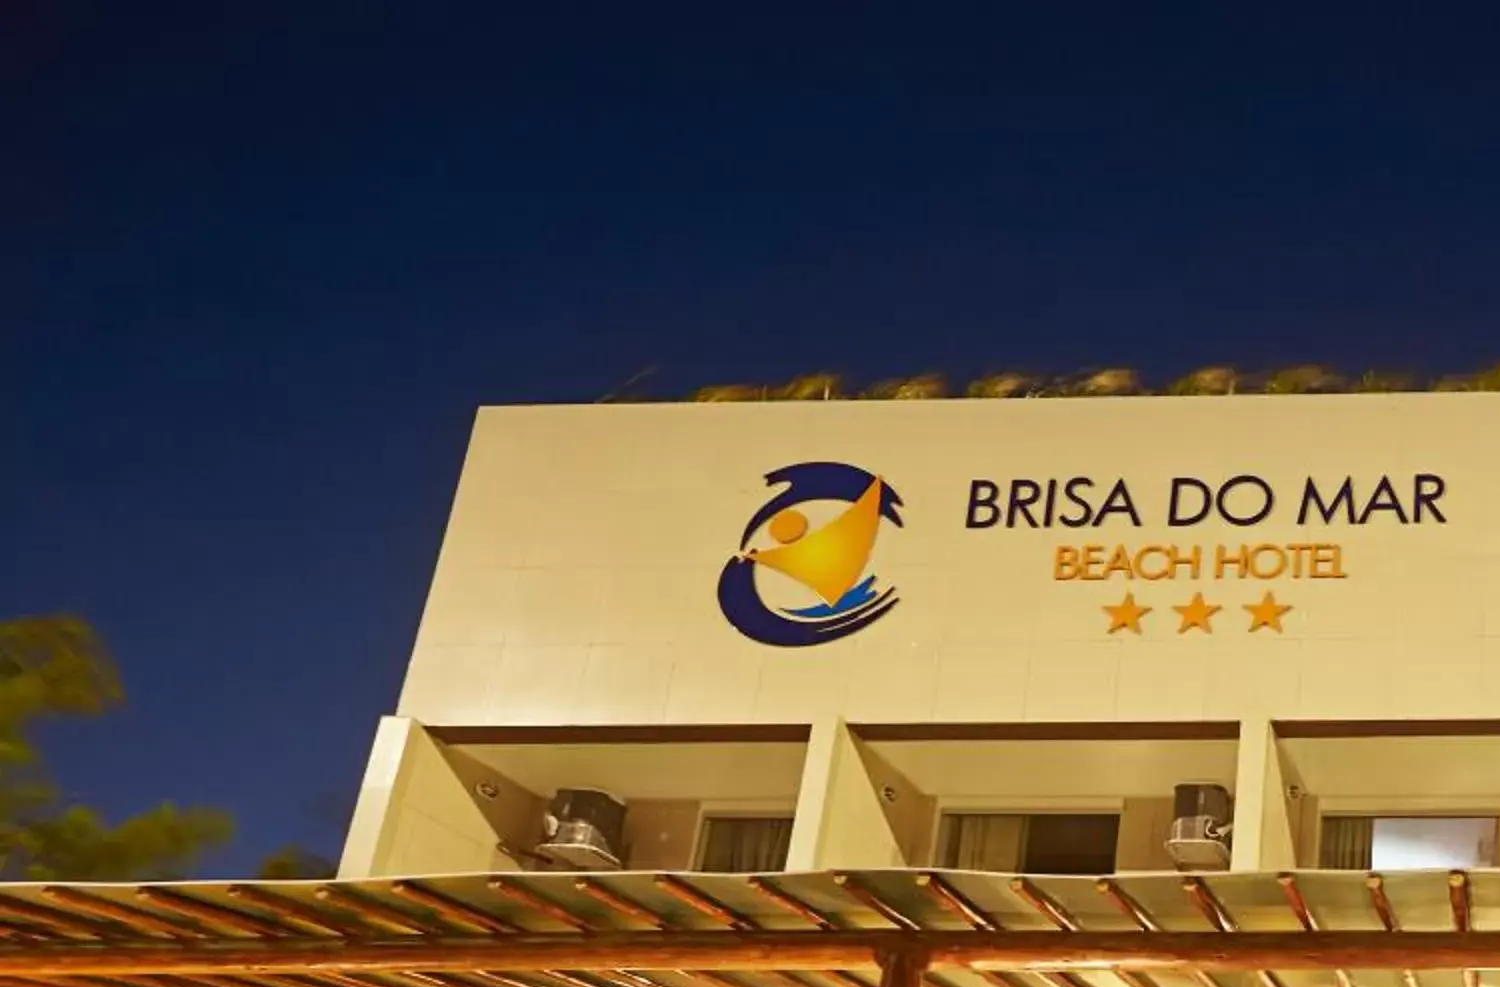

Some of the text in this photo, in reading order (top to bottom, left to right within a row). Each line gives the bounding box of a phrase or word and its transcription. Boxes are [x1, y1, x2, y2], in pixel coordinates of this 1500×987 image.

[965, 473, 1448, 529] BRISA DO MAR
[1053, 543, 1348, 581] BEACH HOTEL
